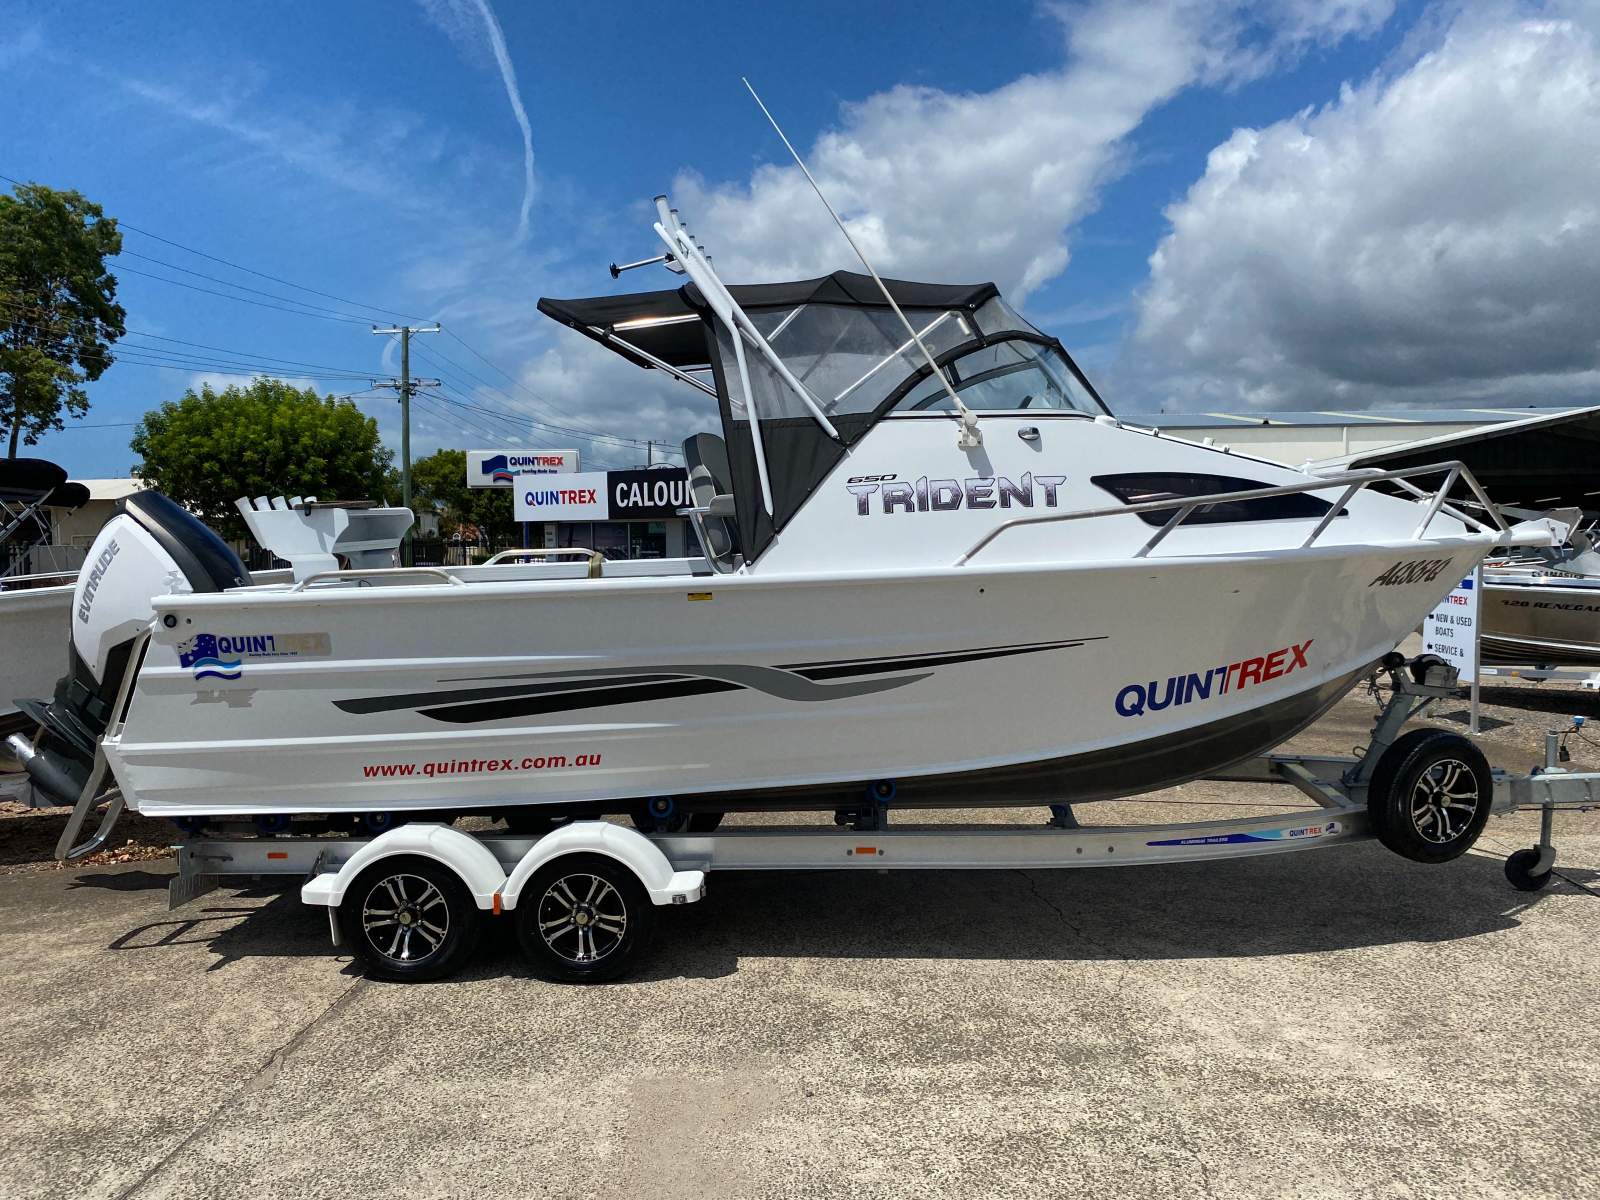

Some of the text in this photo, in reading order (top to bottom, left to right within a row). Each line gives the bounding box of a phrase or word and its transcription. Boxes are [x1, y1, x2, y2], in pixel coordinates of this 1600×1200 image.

[509, 456, 563, 466] QUINTREX
[847, 474, 897, 483] 650
[525, 490, 596, 506] QUINTREX
[846, 471, 1067, 515] TRIDENT
[78, 540, 120, 624] EVINRUDE
[1436, 613, 1472, 627] NEW & USED
[1435, 626, 1454, 638] BOATS
[1435, 644, 1465, 658] SERVICE &
[1115, 639, 1314, 717] QUINTREX
[363, 753, 602, 778] www.quintrex.com.au
